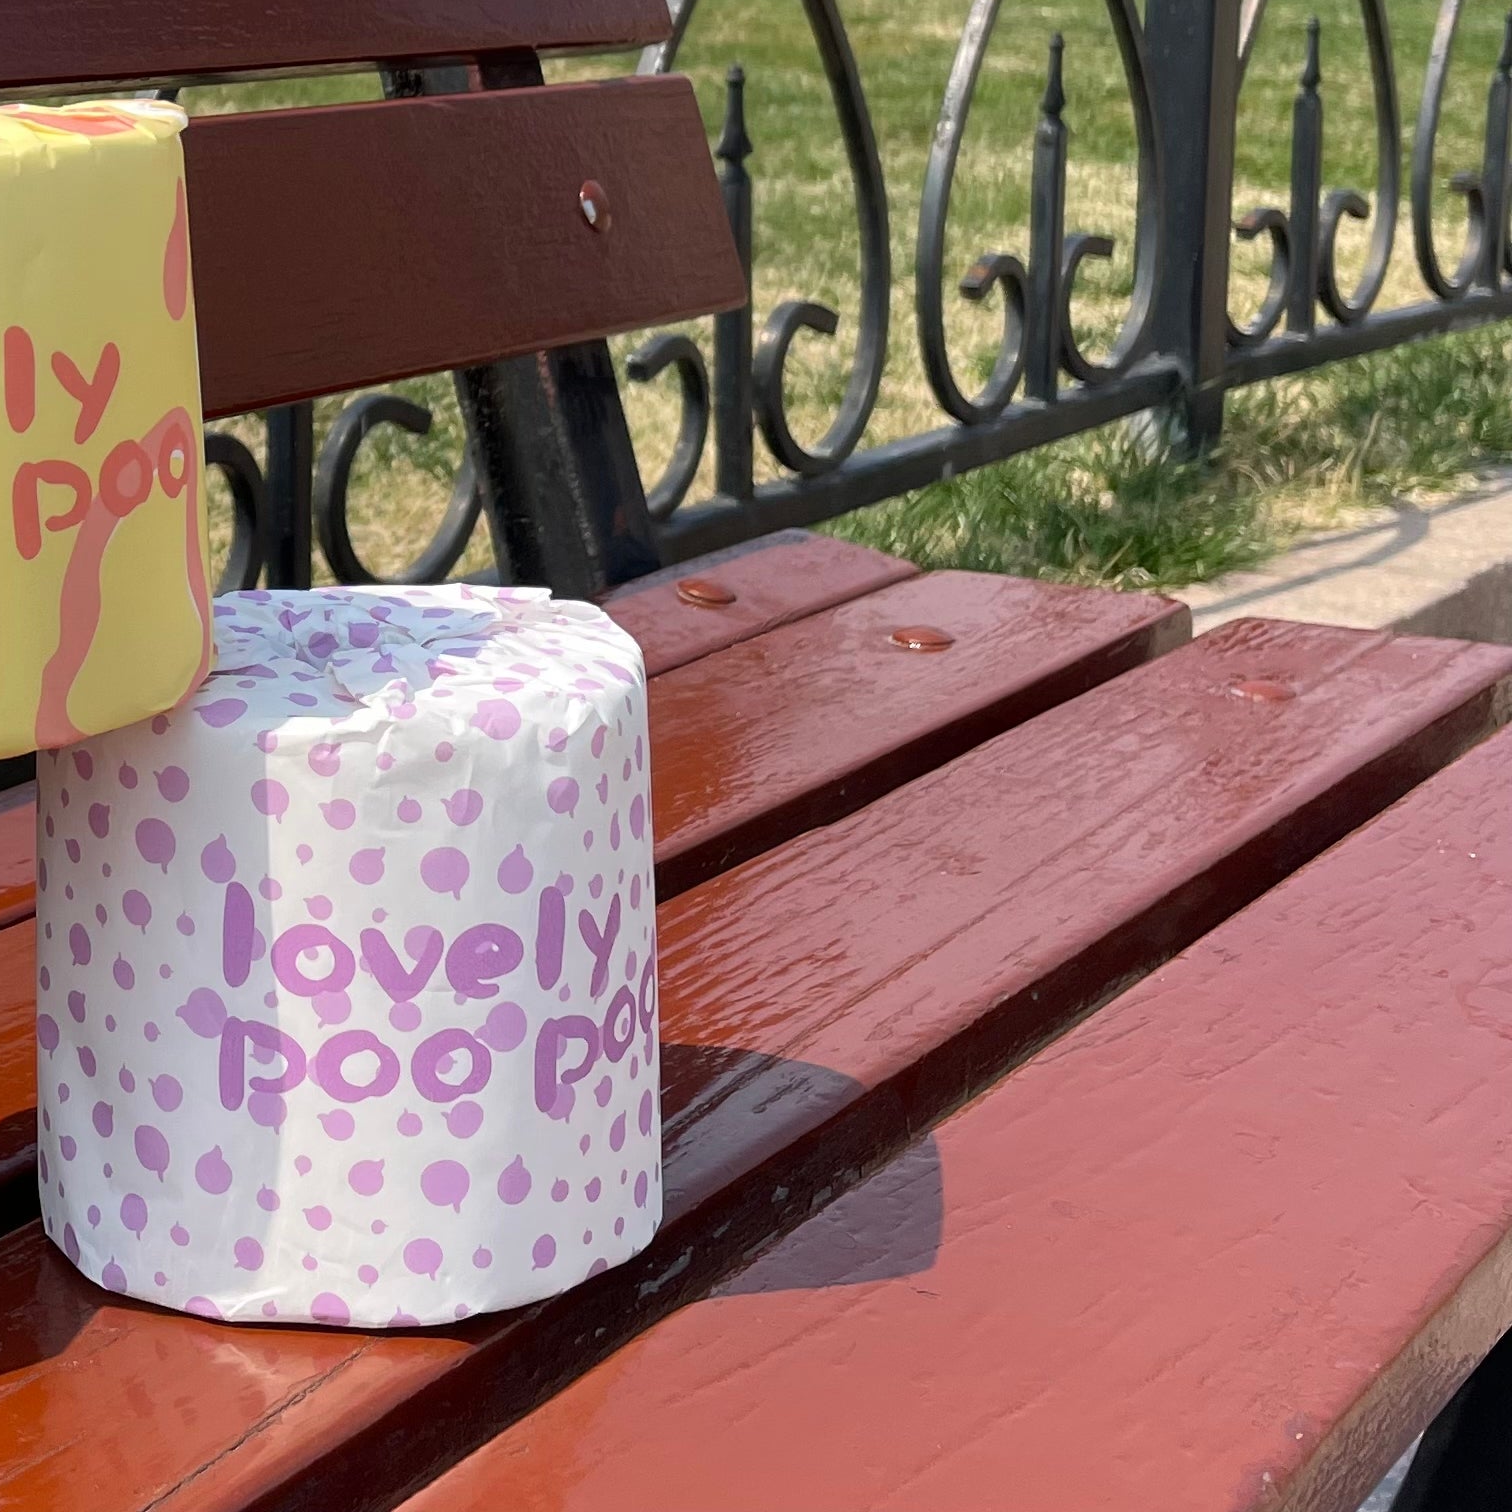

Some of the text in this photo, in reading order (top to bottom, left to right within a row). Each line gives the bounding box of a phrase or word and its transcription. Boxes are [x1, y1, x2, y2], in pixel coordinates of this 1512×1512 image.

[11, 422, 189, 561] poo
[221, 881, 621, 1003] lovely
[218, 1016, 492, 1112] poo
